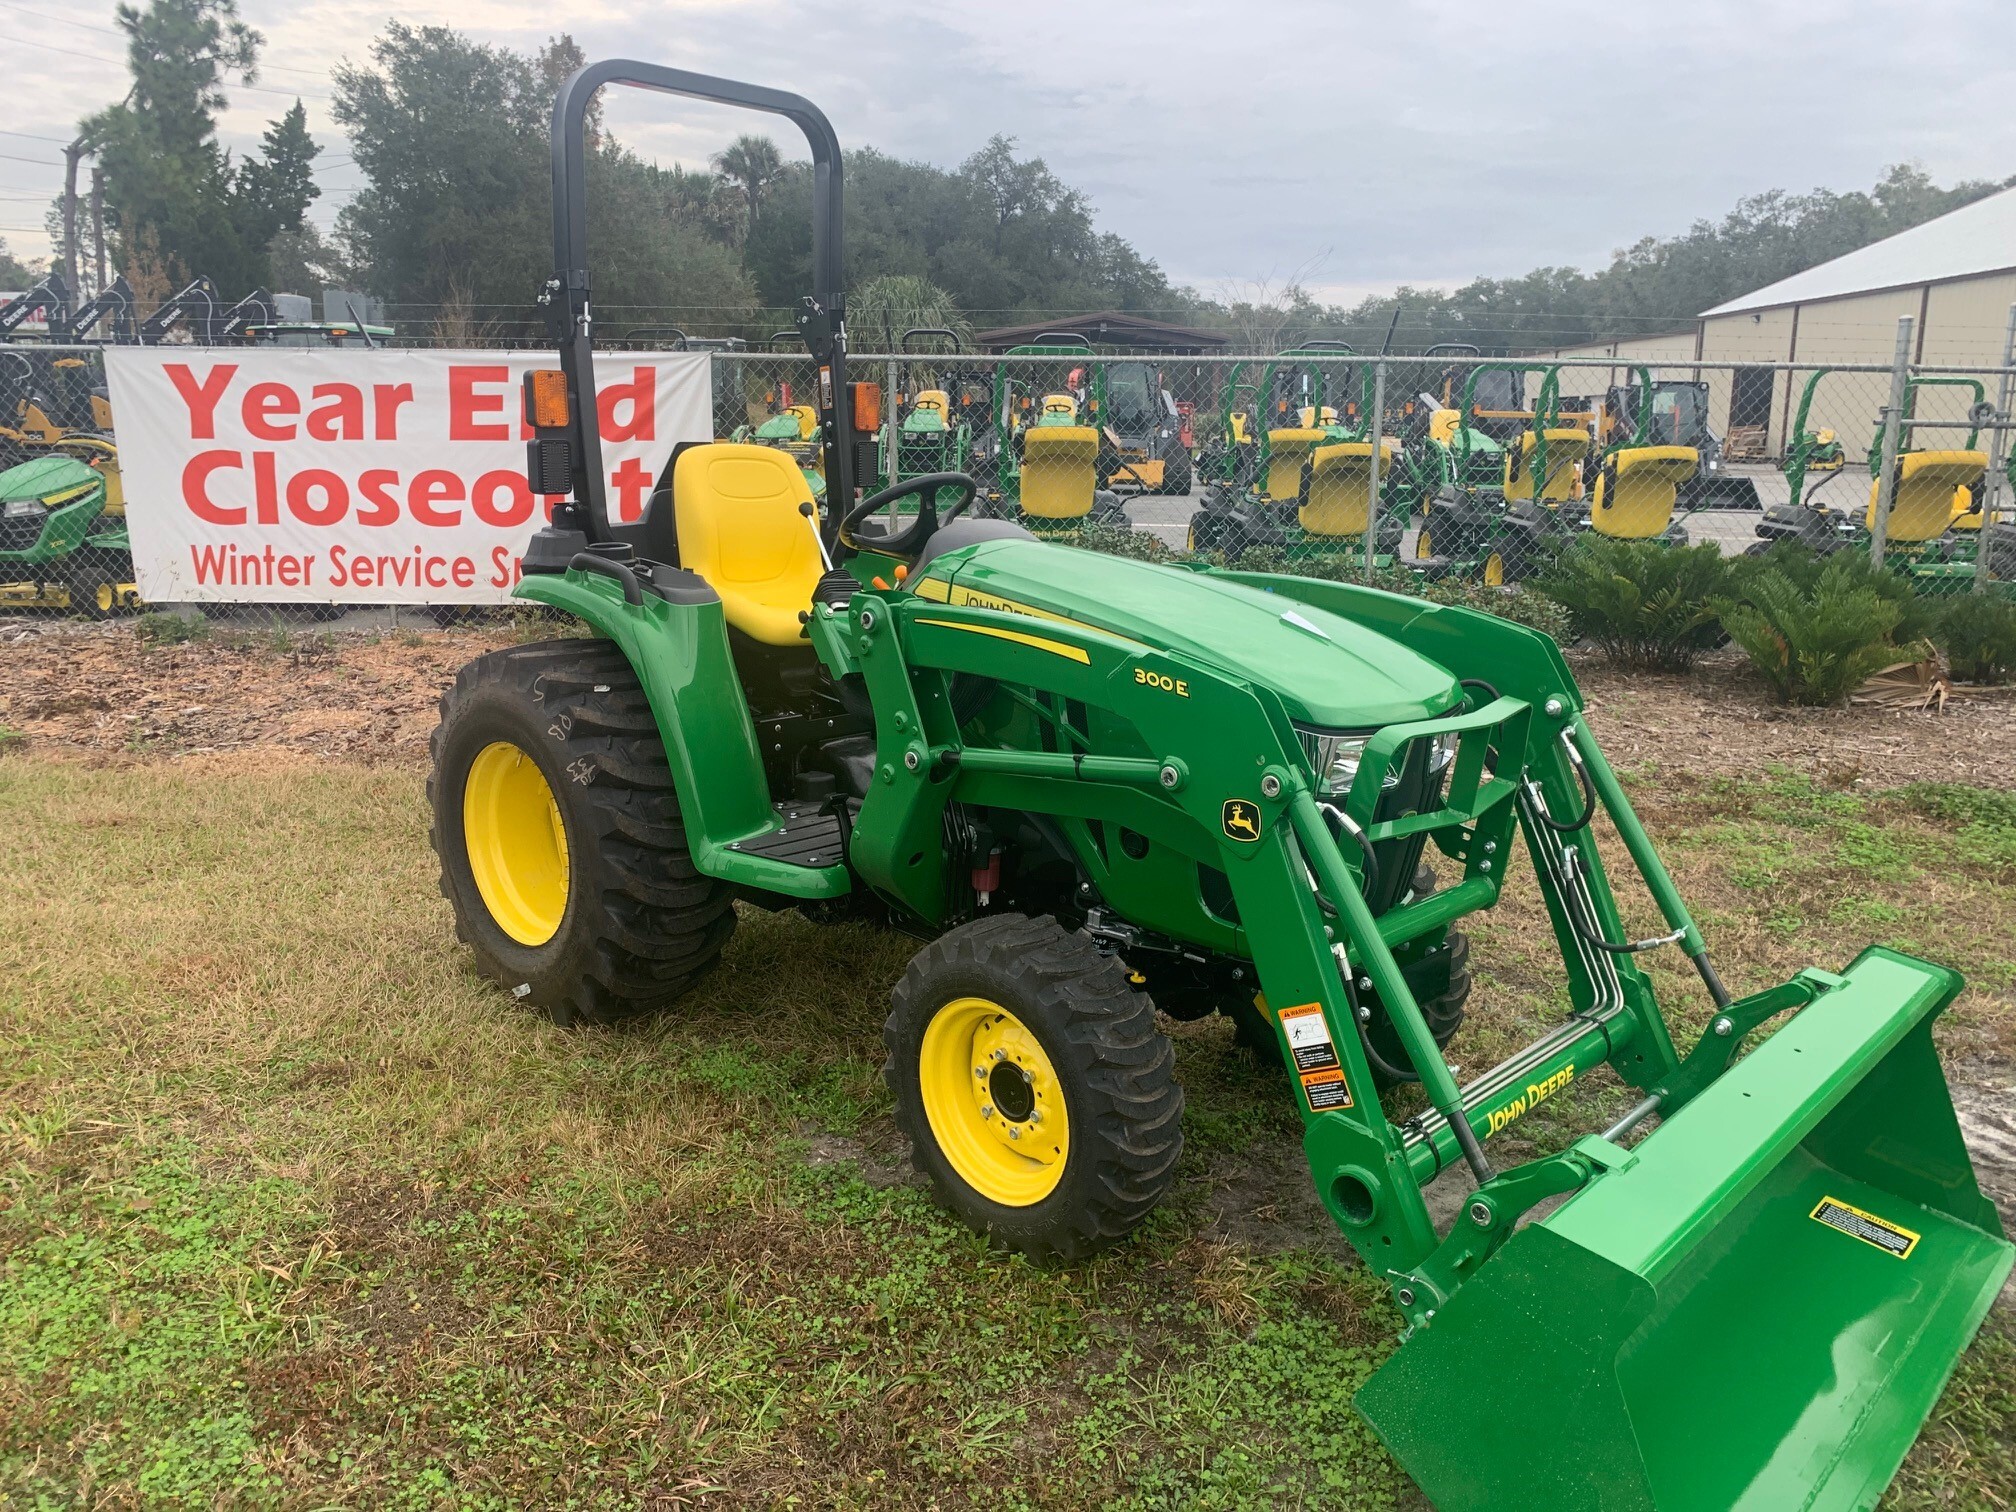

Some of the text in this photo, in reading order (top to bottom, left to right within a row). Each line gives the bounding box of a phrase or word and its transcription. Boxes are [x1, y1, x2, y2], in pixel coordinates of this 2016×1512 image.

[3, 304, 28, 327] DEERE
[77, 308, 99, 330] DEERE
[160, 307, 182, 328] DEERE
[162, 364, 414, 442] Year
[1031, 530, 1051, 538] OHN
[190, 543, 315, 587] Winter
[328, 544, 476, 588] Service
[1485, 1063, 1575, 1139] JOHN DEERE
[1860, 1212, 1898, 1231] CAUTION
